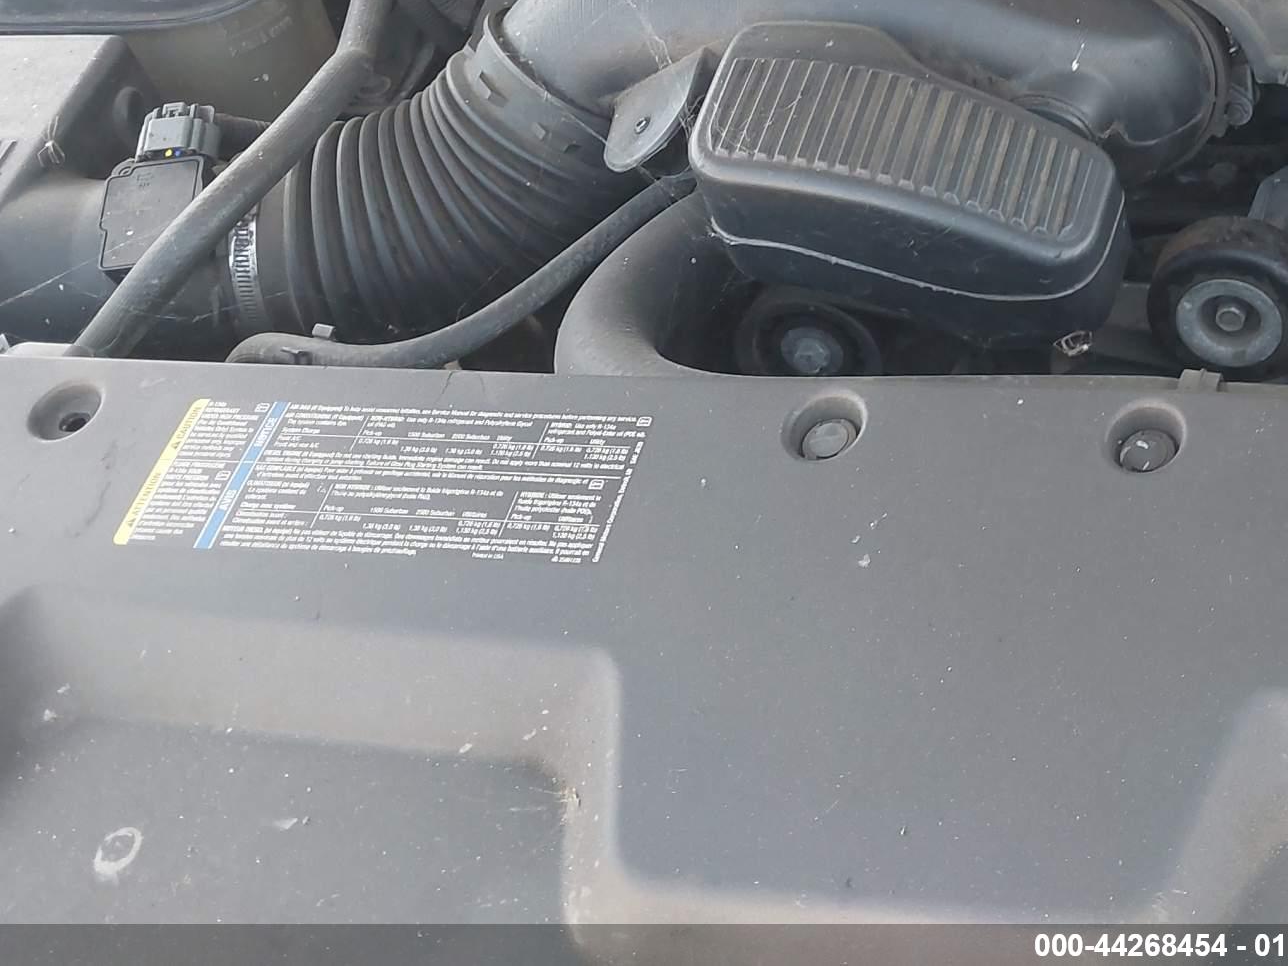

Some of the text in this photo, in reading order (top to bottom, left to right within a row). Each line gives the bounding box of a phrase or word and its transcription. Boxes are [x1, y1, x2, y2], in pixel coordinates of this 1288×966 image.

[177, 406, 203, 438] CAUTION
[254, 418, 278, 447] NOTICE
[134, 472, 162, 516] ATTENTION
[218, 489, 237, 510] AVIS
